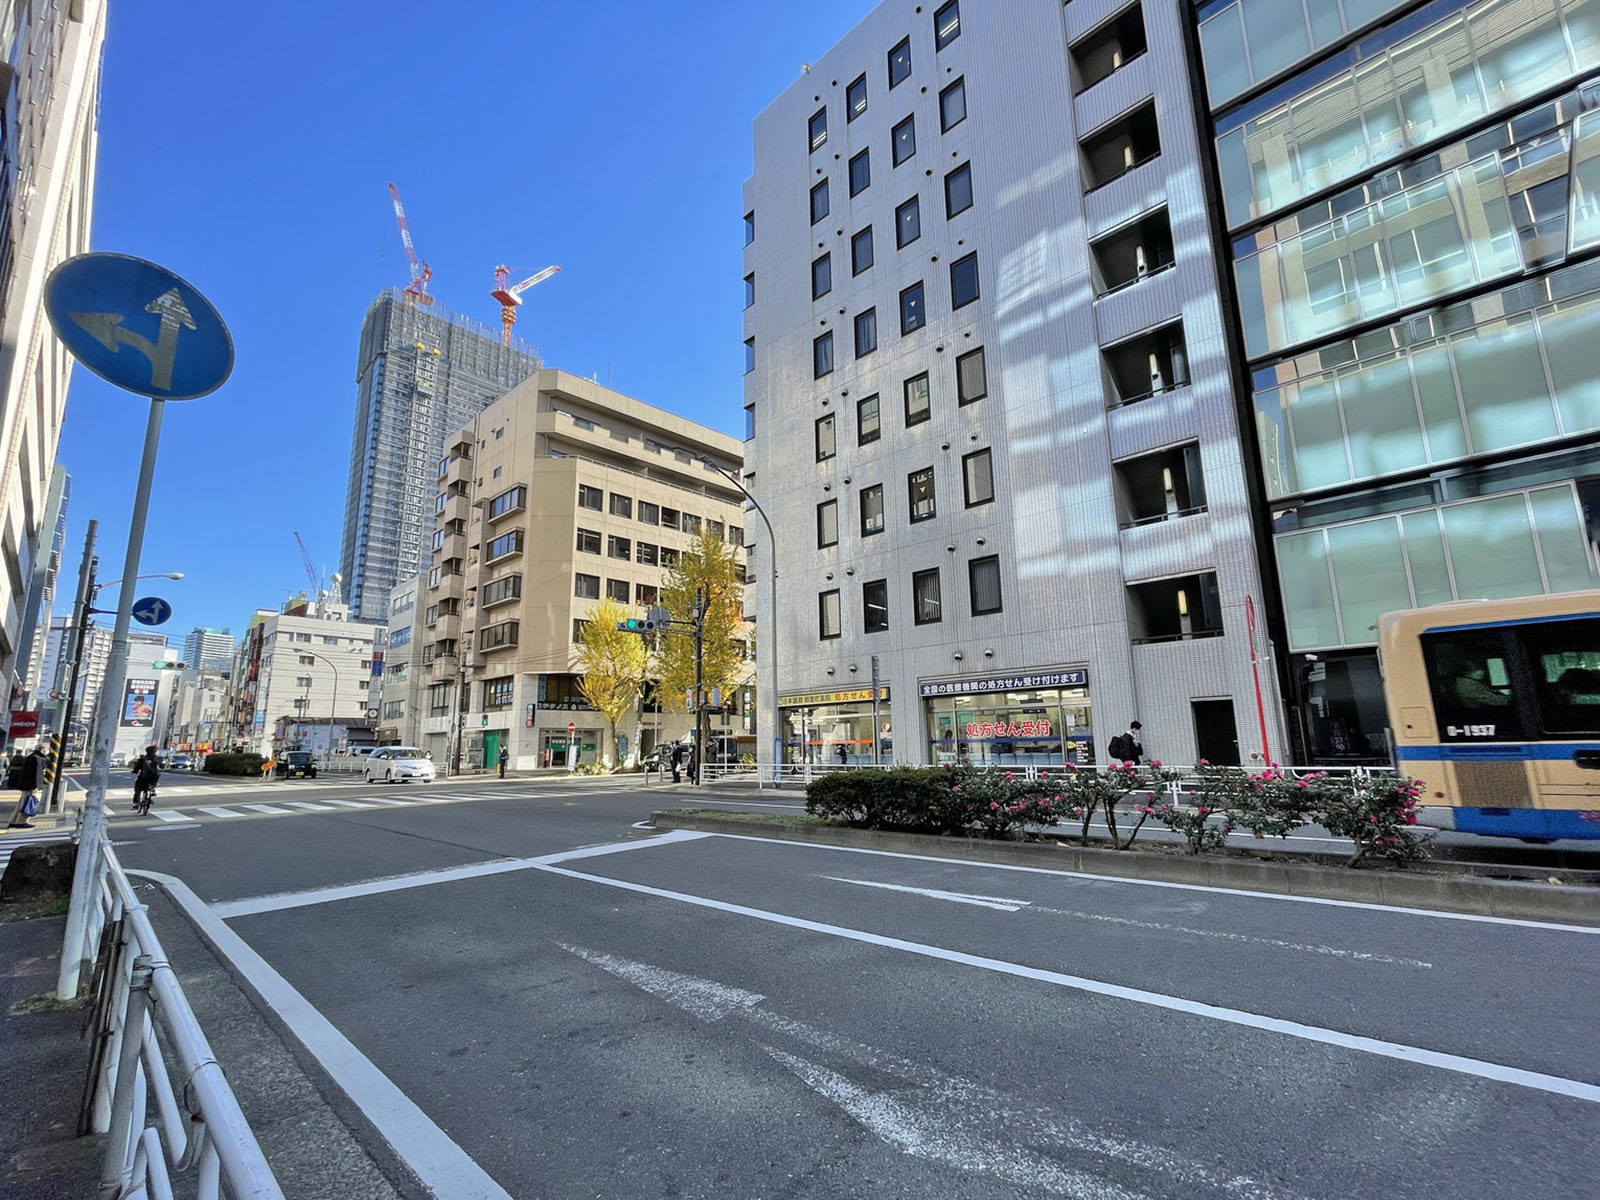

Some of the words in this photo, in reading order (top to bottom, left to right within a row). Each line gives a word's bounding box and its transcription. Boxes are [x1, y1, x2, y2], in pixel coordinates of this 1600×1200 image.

[923, 672, 1079, 694] 全国の医療機関の処方せん受け付けます
[966, 719, 1050, 737] 処方せん受付
